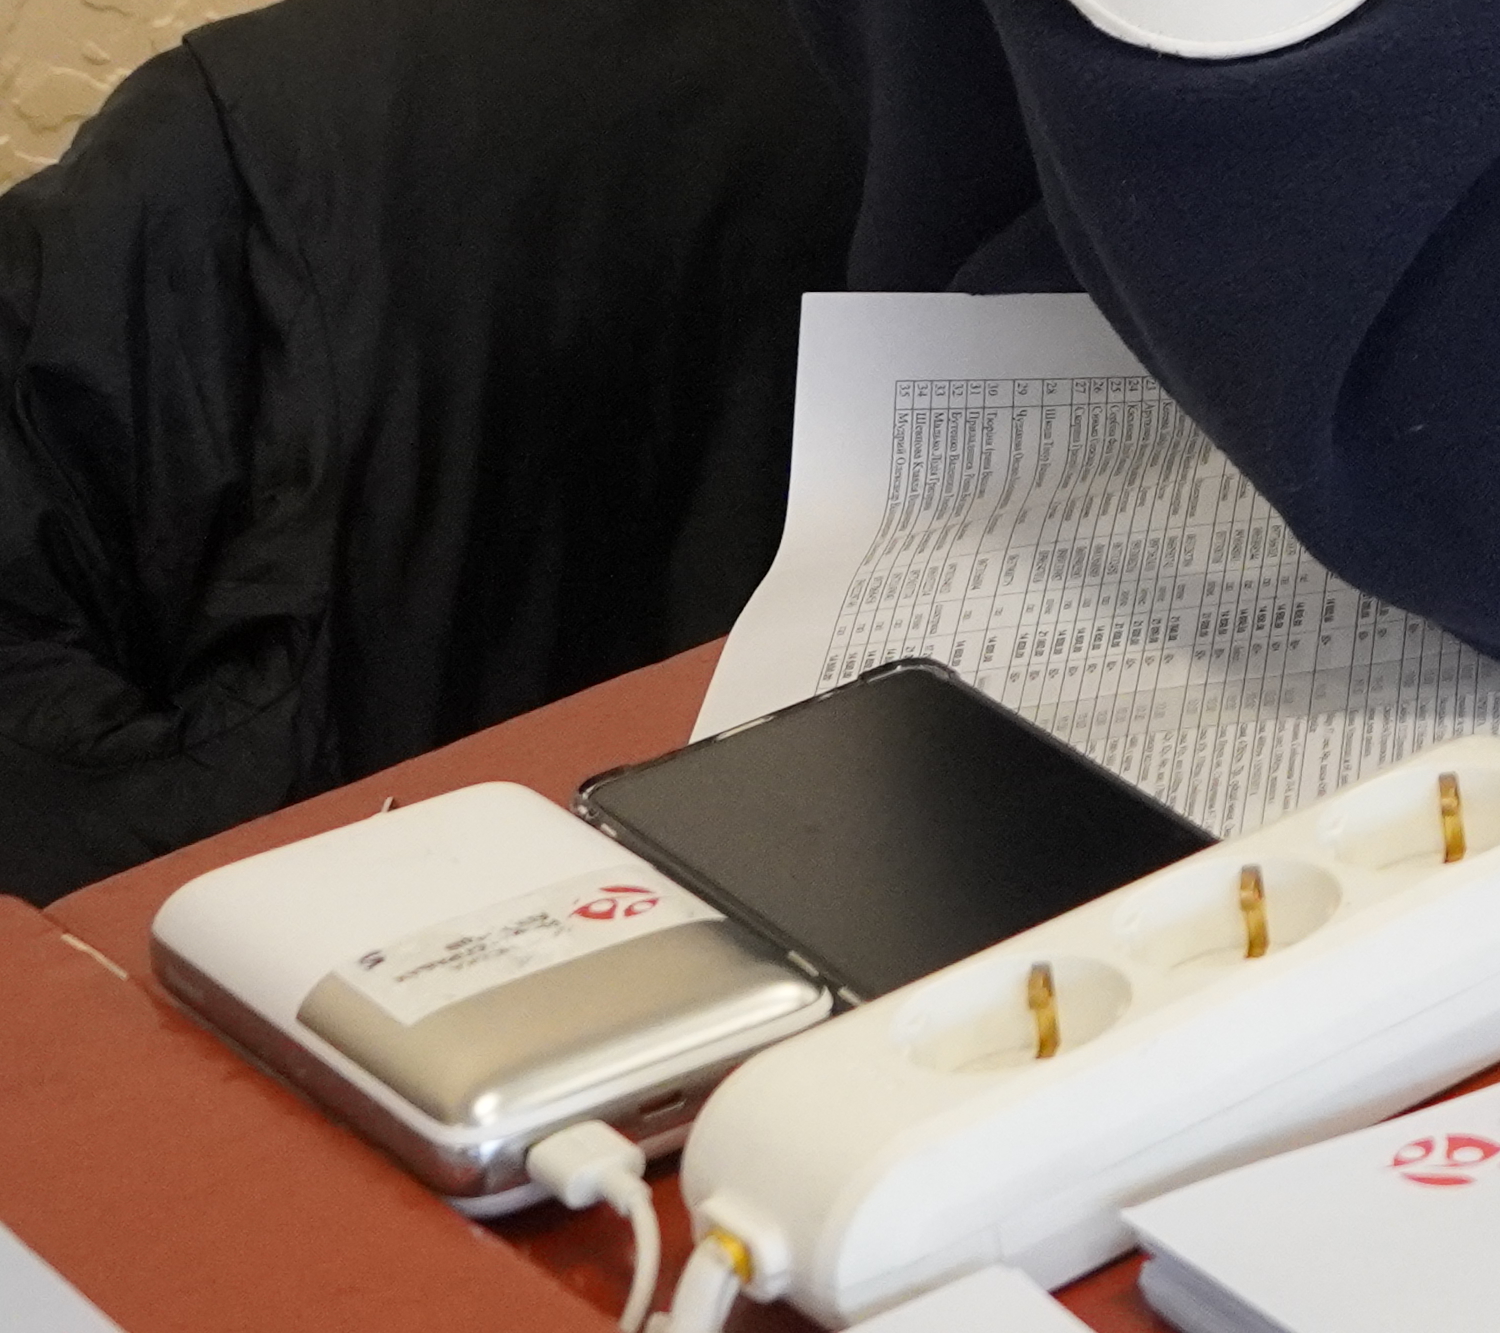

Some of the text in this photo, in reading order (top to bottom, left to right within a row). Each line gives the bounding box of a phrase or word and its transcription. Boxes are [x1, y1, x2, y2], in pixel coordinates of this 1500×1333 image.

[900, 385, 910, 397] 35
[918, 385, 928, 397] 34
[935, 384, 946, 397] 33
[952, 383, 964, 397] 32
[971, 383, 981, 396] 31
[1017, 384, 1027, 395] 29
[1076, 382, 1086, 393] 27
[1111, 381, 1121, 393] 25
